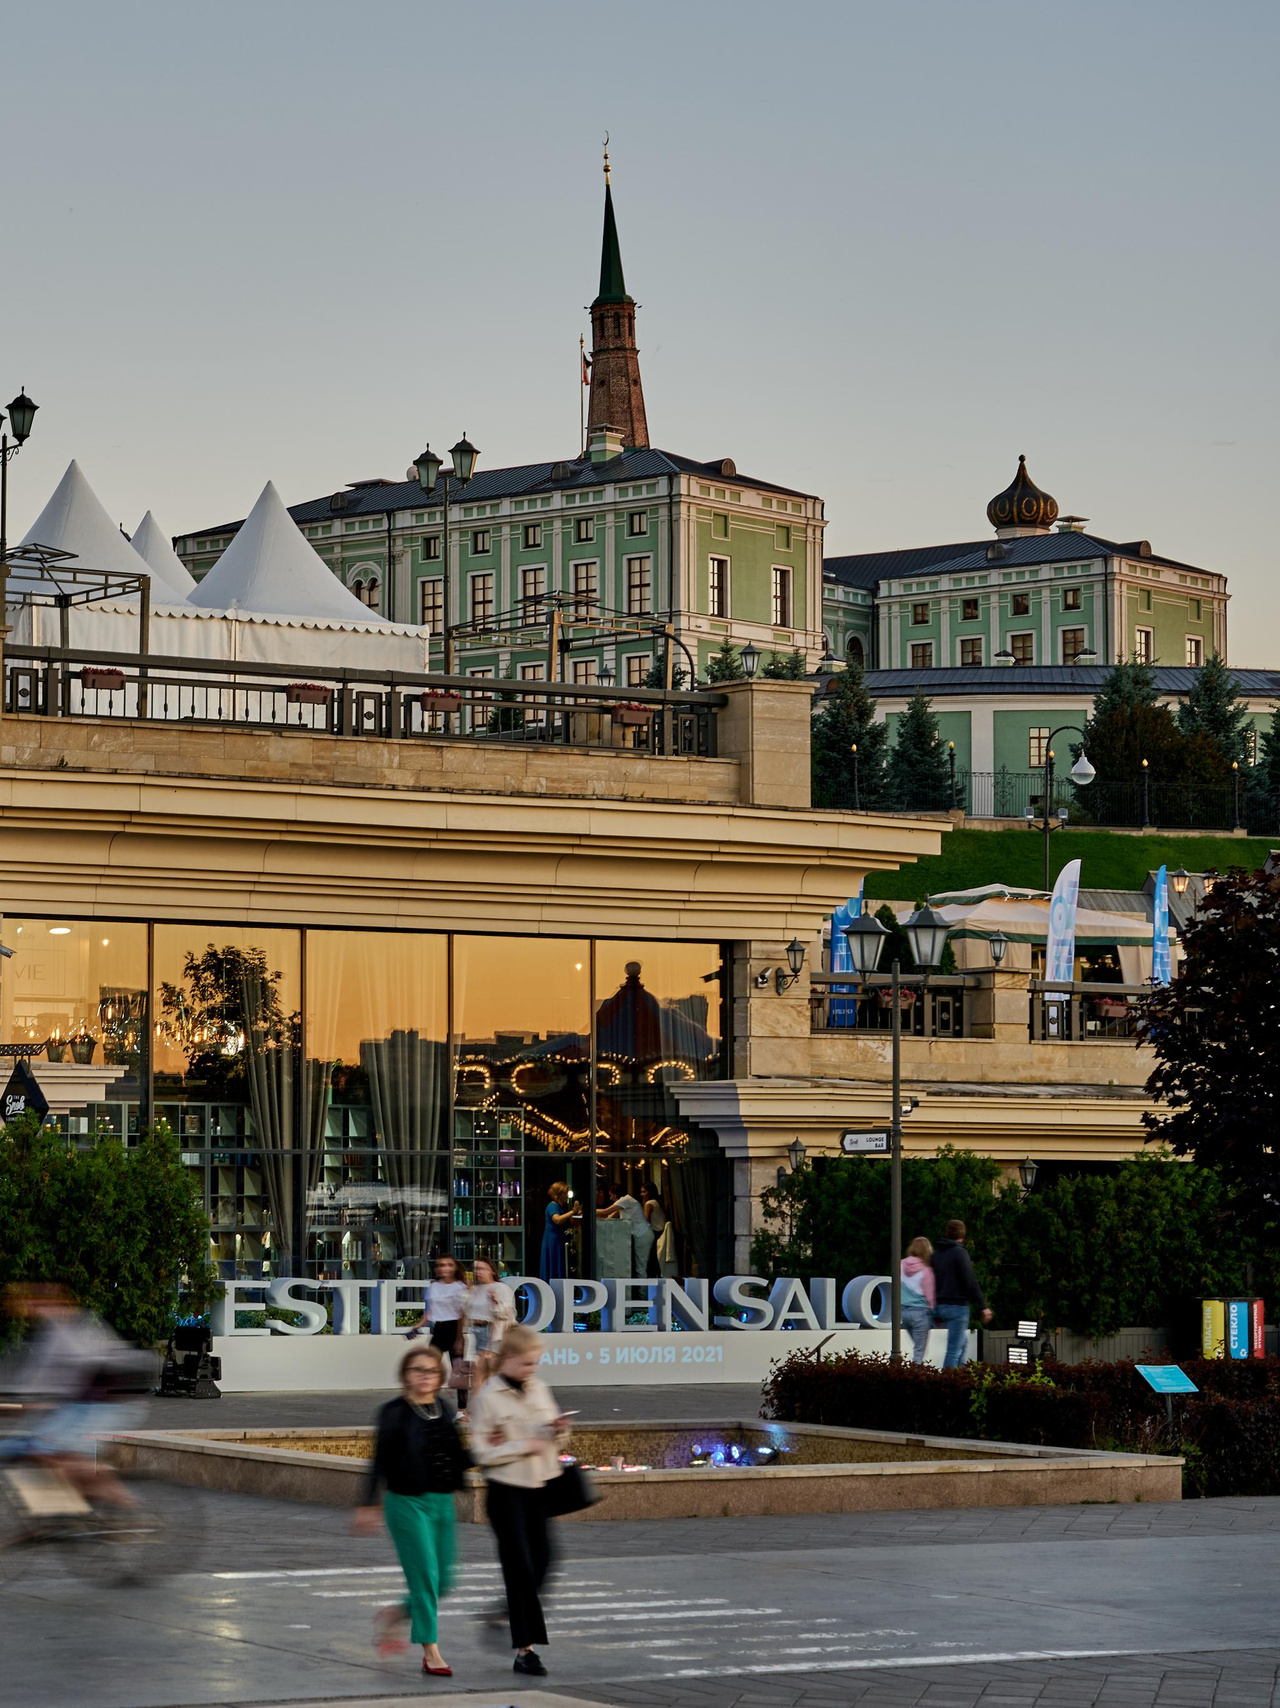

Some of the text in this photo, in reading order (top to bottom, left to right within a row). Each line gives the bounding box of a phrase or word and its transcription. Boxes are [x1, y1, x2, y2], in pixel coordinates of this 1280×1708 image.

[5, 1094, 26, 1116] Snob
[217, 1275, 892, 1336] ESTE OPENSALO
[1204, 1305, 1212, 1350] ПЛАСТИК
[538, 1344, 724, 1366] АНЬ 5 ИЮЛЯ 2021
